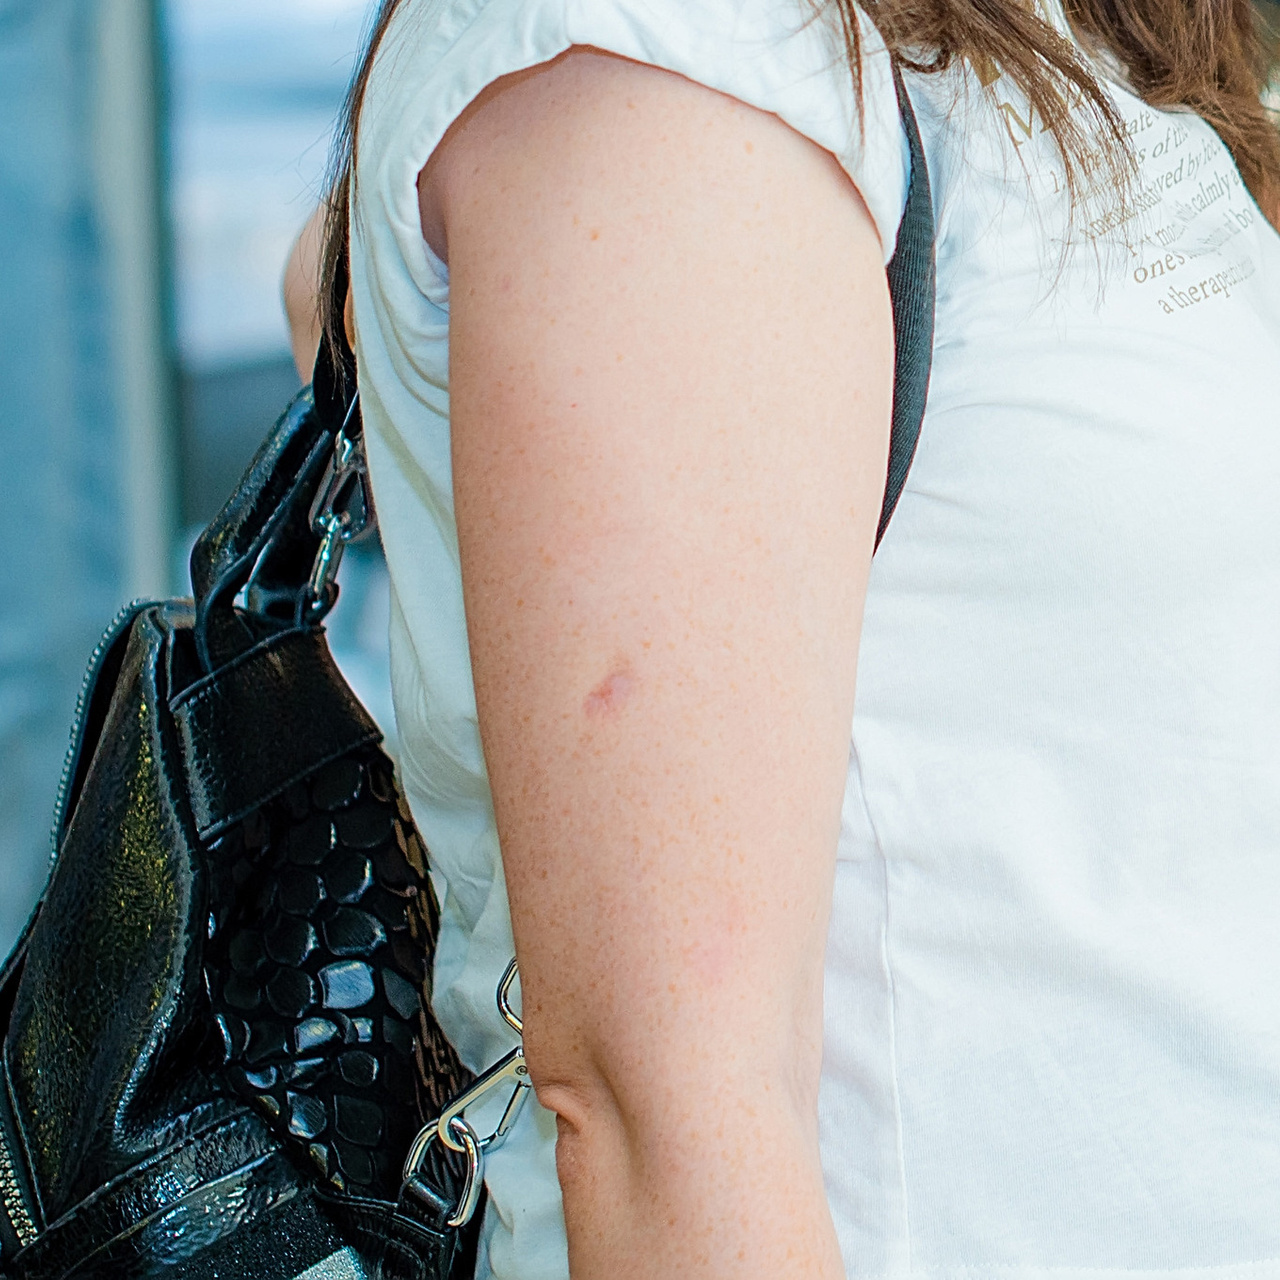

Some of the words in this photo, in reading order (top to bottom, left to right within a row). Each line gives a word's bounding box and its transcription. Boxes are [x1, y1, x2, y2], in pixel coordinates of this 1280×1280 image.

[1151, 126, 1172, 159] of
[1186, 151, 1202, 181] by
[1190, 170, 1232, 213] calmly
[1158, 298, 1175, 315] a
